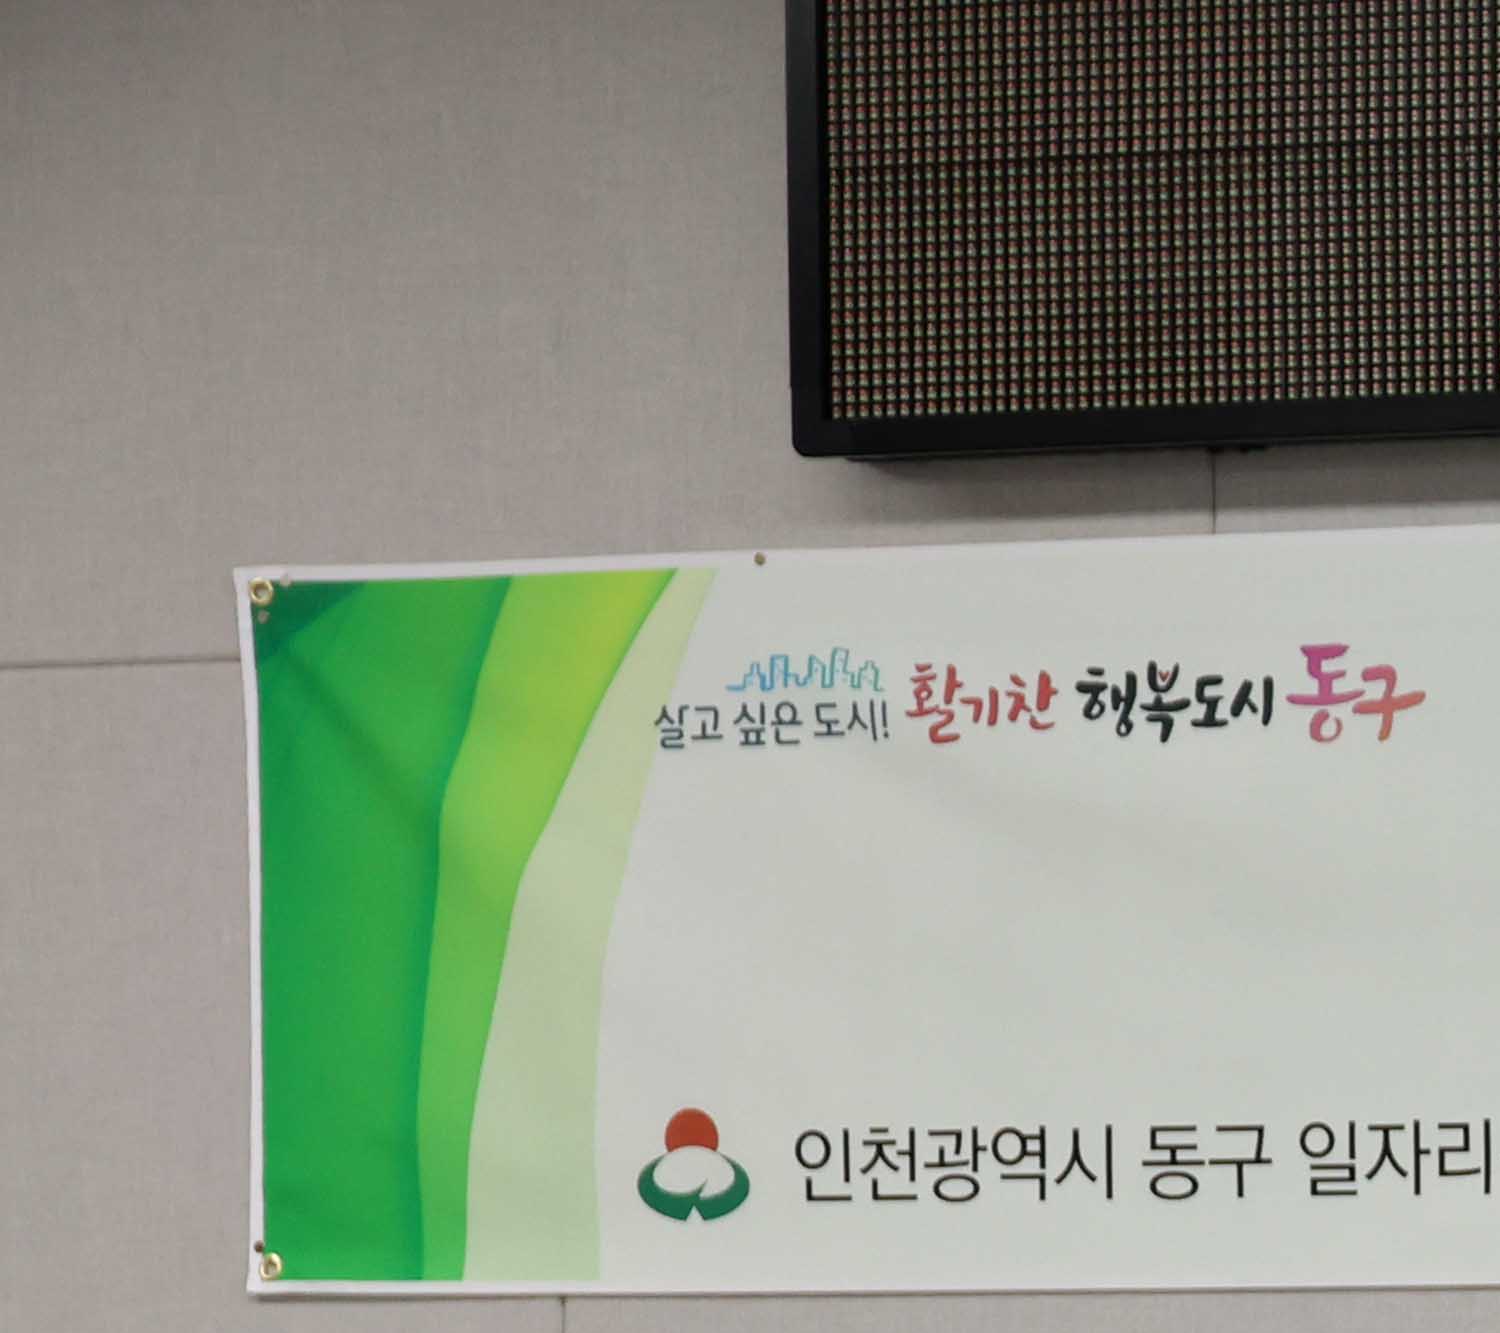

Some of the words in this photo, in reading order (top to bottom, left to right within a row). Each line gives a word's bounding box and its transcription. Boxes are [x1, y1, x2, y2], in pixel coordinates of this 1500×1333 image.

[653, 704, 724, 750] 살고
[733, 700, 804, 747] 싶은
[812, 699, 890, 743] 도시!
[905, 663, 1058, 745] 활기찬
[1075, 660, 1274, 745] 행복도시
[1285, 643, 1426, 743] 동구
[793, 1123, 1114, 1204] 인천광역시
[1140, 1124, 1274, 1202] 동구
